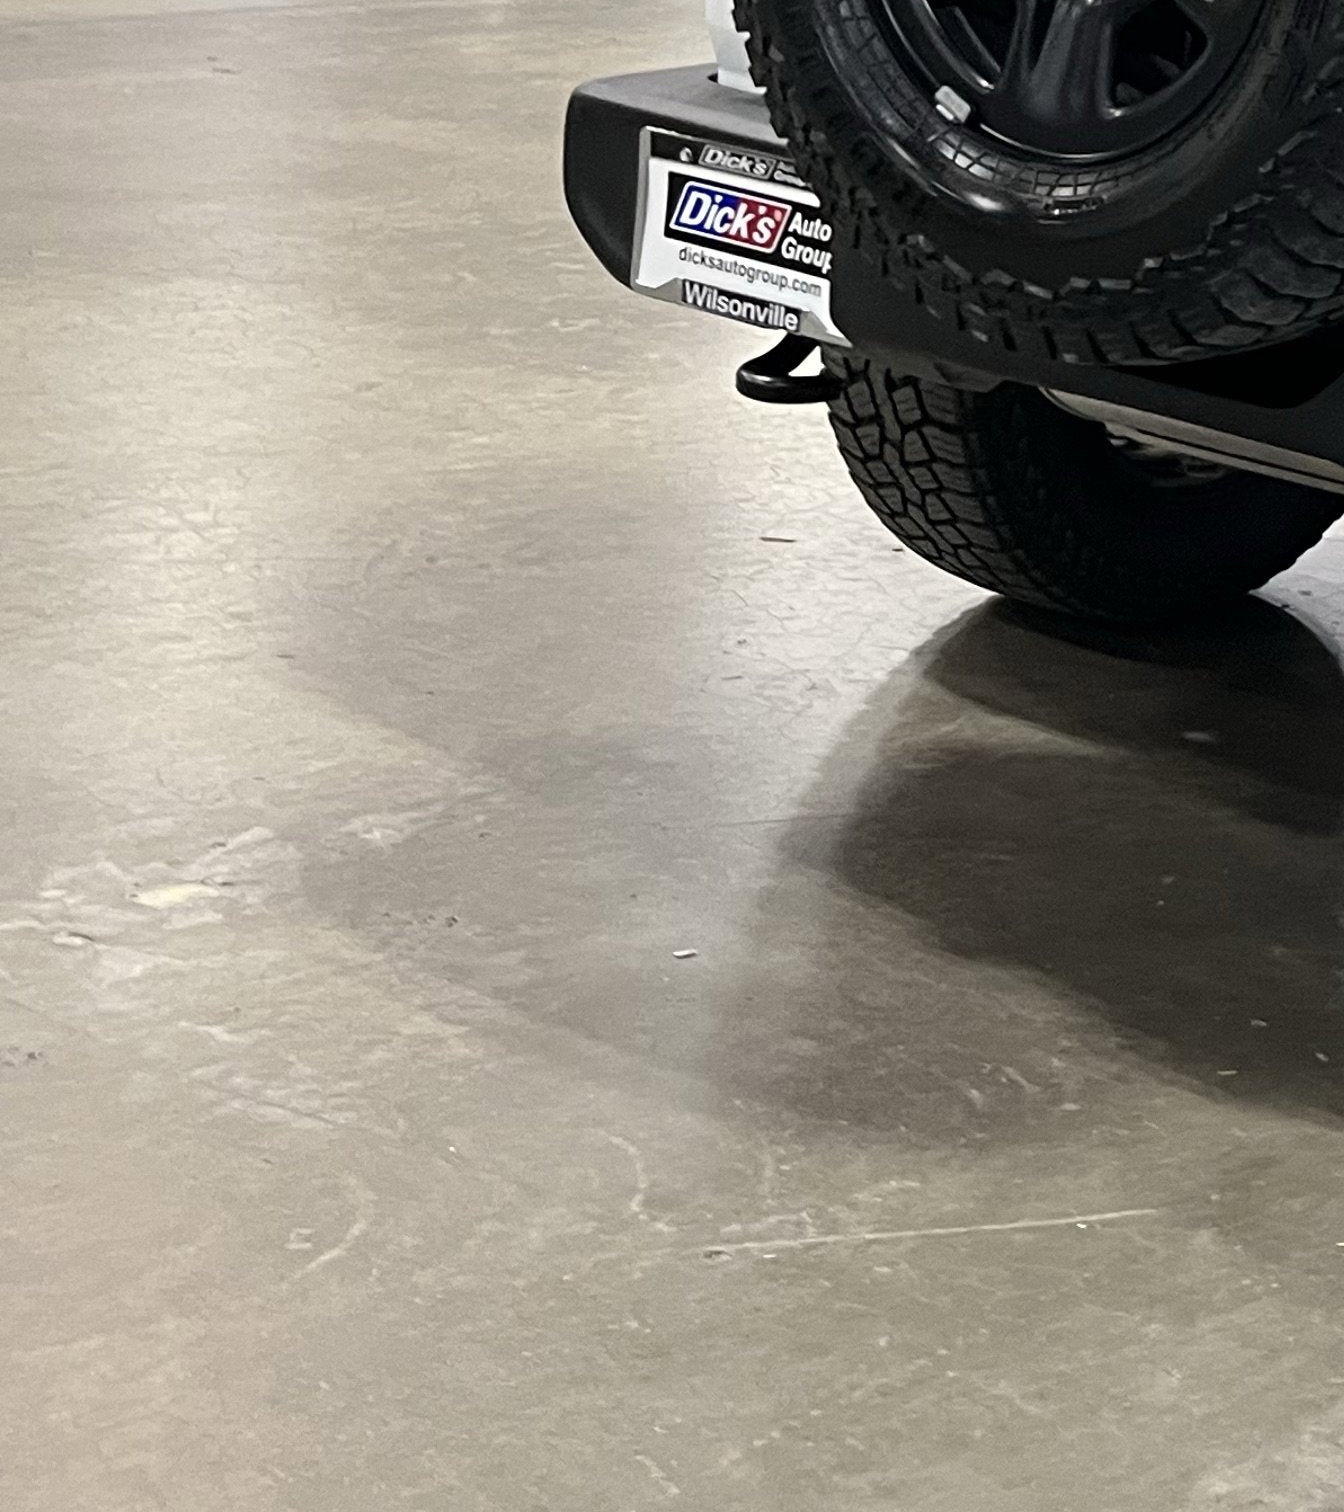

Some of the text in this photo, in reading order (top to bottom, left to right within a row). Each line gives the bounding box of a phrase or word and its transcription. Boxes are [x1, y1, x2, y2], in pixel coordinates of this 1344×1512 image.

[704, 148, 768, 176] Dick's
[679, 190, 777, 245] Dick's
[788, 211, 833, 242] Auto
[678, 246, 823, 298] dicksautogroup.com
[684, 279, 799, 331] Wilsonville
